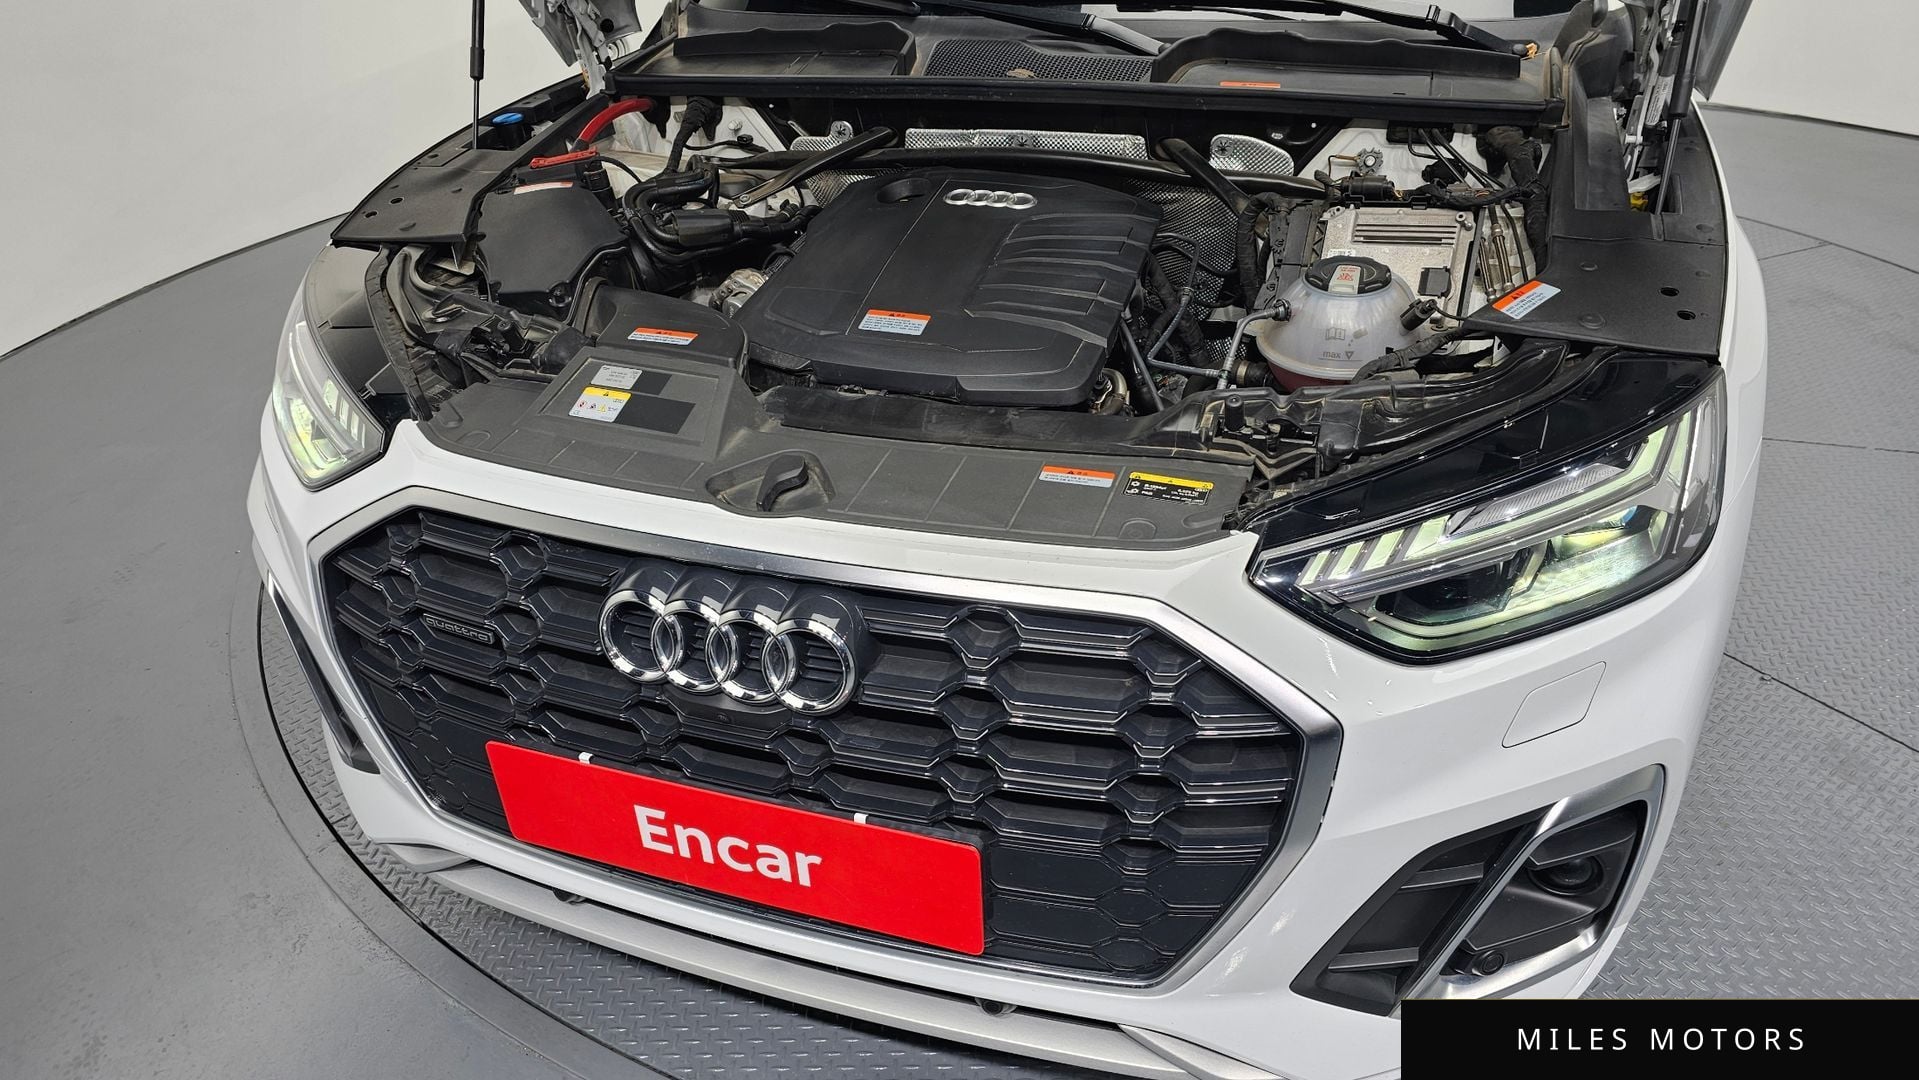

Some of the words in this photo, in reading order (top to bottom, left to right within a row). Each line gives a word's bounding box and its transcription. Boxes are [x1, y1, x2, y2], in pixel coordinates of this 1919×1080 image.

[1322, 351, 1341, 359] max
[425, 617, 488, 641] quattro
[634, 804, 822, 887] Encar
